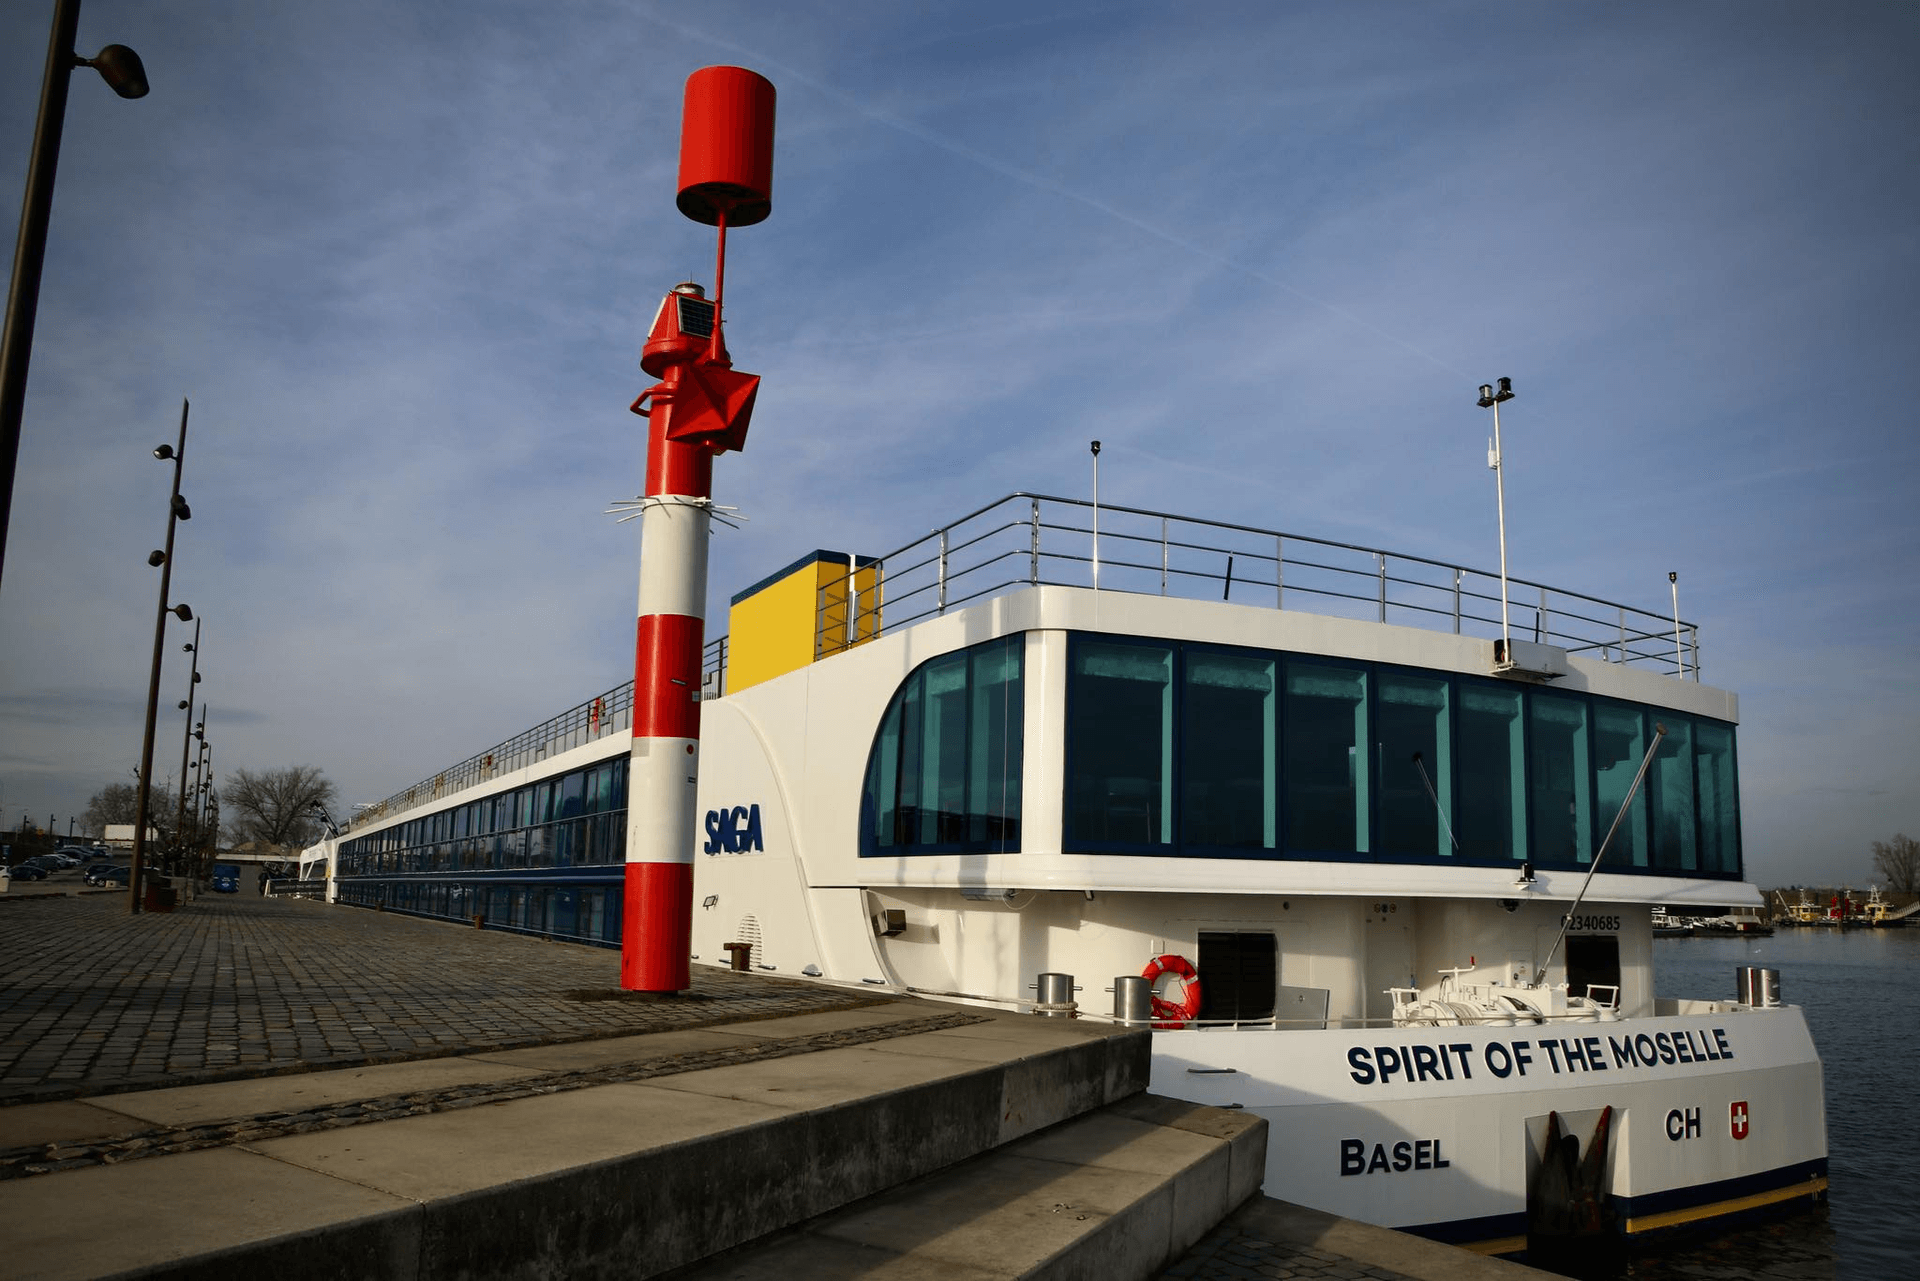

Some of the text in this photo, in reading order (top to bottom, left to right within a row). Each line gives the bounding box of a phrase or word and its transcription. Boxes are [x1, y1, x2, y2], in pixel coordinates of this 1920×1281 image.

[704, 803, 764, 856] SAGA
[1347, 1028, 1734, 1085] SPIRIT OF THE MOSELLE
[1665, 1107, 1702, 1142] CH
[1340, 1139, 1450, 1177] BASEL
